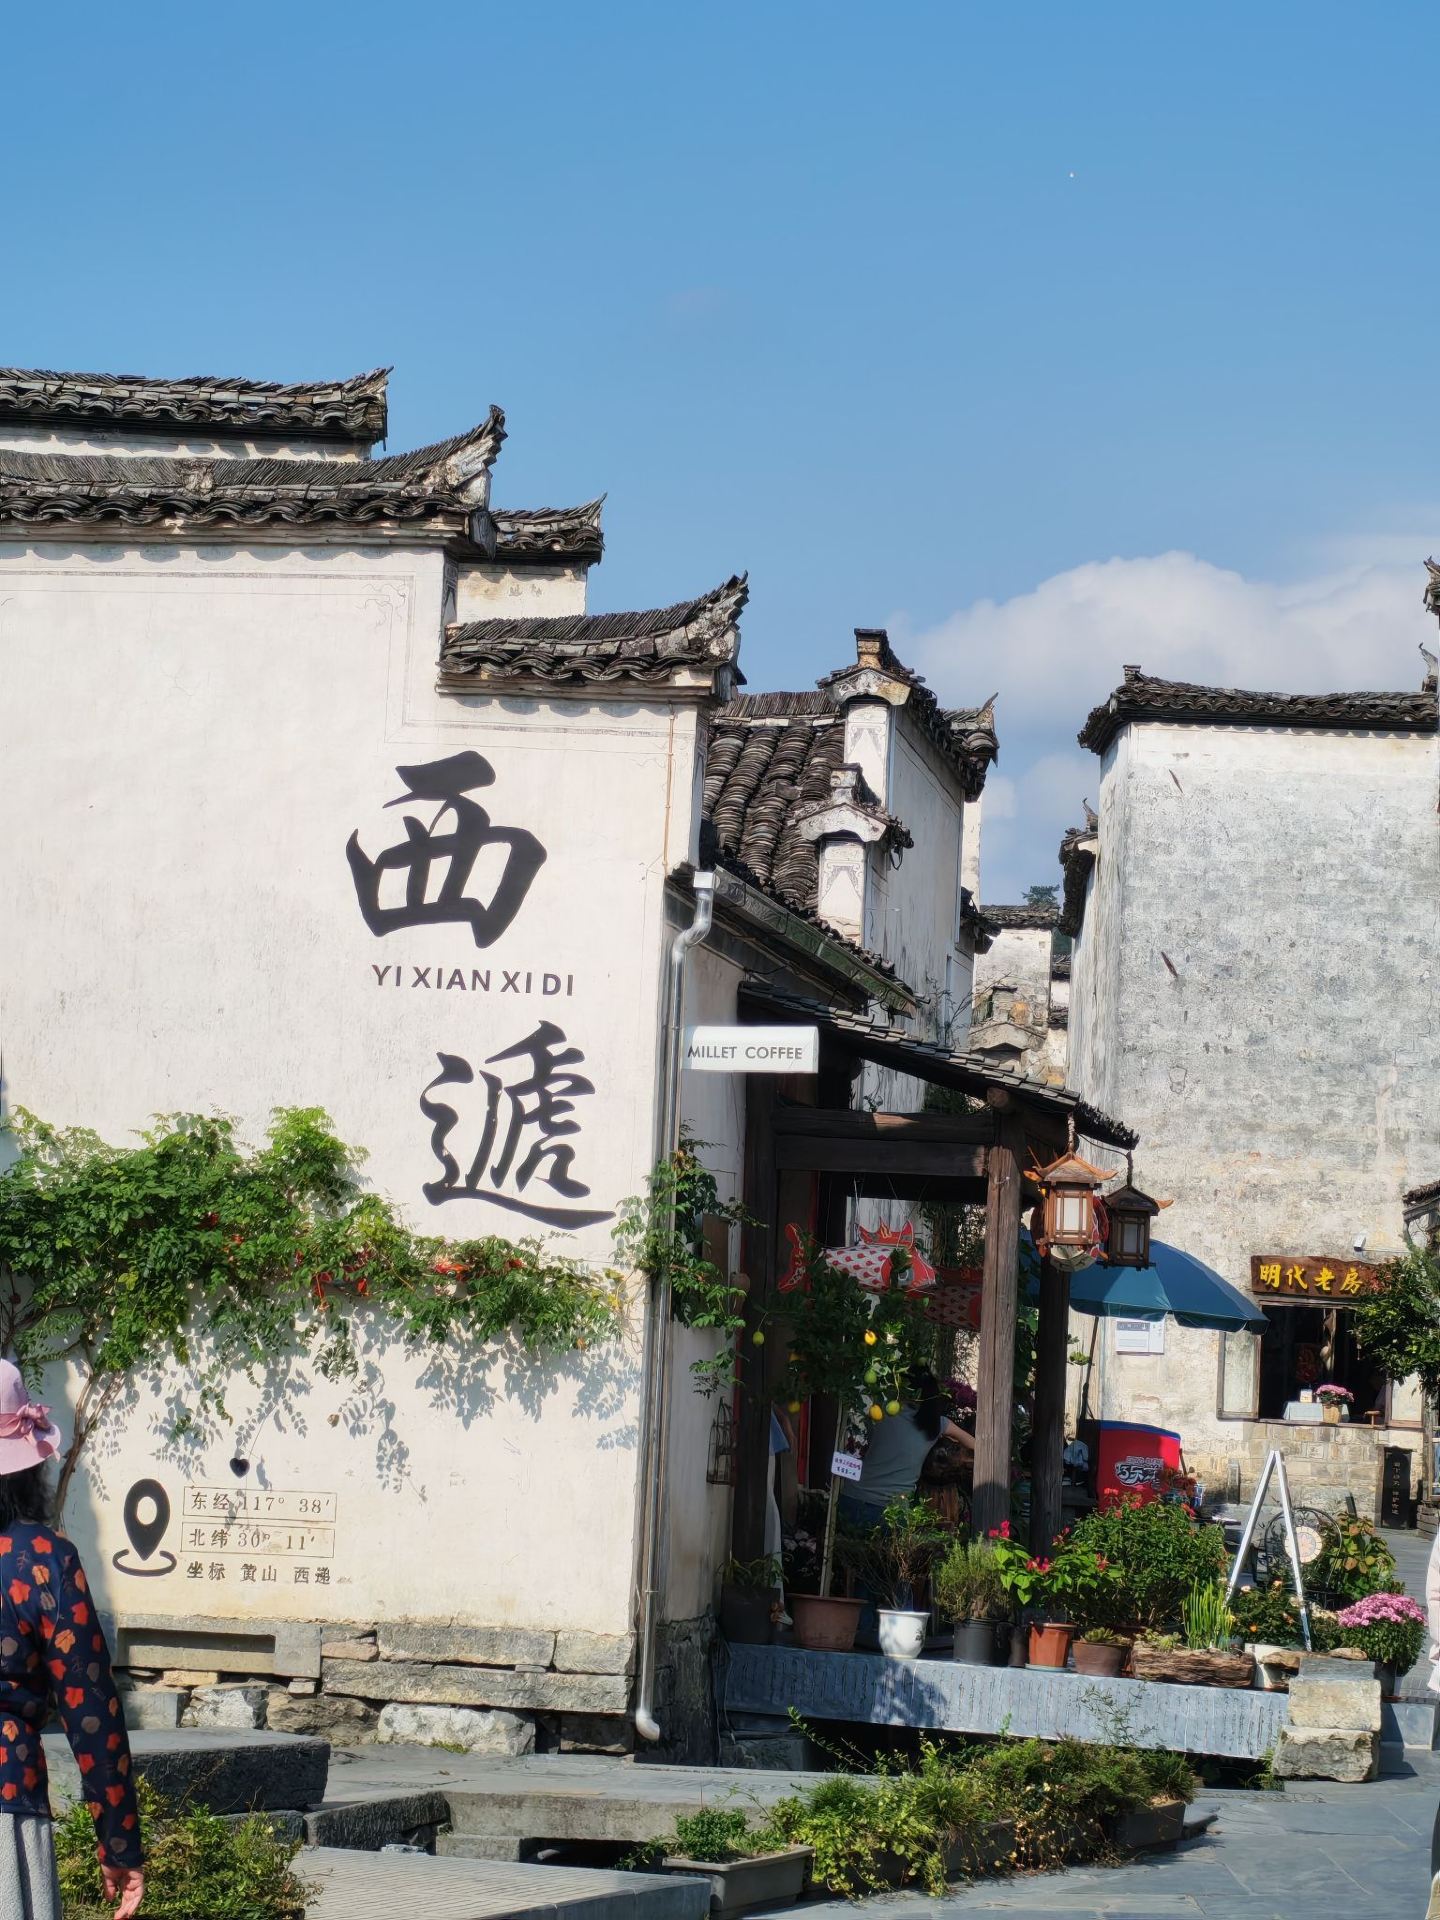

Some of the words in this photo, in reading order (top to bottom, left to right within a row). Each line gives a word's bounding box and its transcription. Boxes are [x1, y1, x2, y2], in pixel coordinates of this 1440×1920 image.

[346, 750, 547, 949] 西
[372, 965, 401, 986] YI
[412, 967, 490, 991] XIAN
[687, 1045, 737, 1058] MILLET
[745, 1046, 803, 1060] COFFEE
[1259, 1263, 1363, 1294] 明代老房
[191, 1491, 230, 1511] 东经
[188, 1528, 228, 1549] 北纬
[186, 1560, 226, 1581] 坐标
[240, 1563, 278, 1582] 黄山
[293, 1566, 331, 1585] 西递
